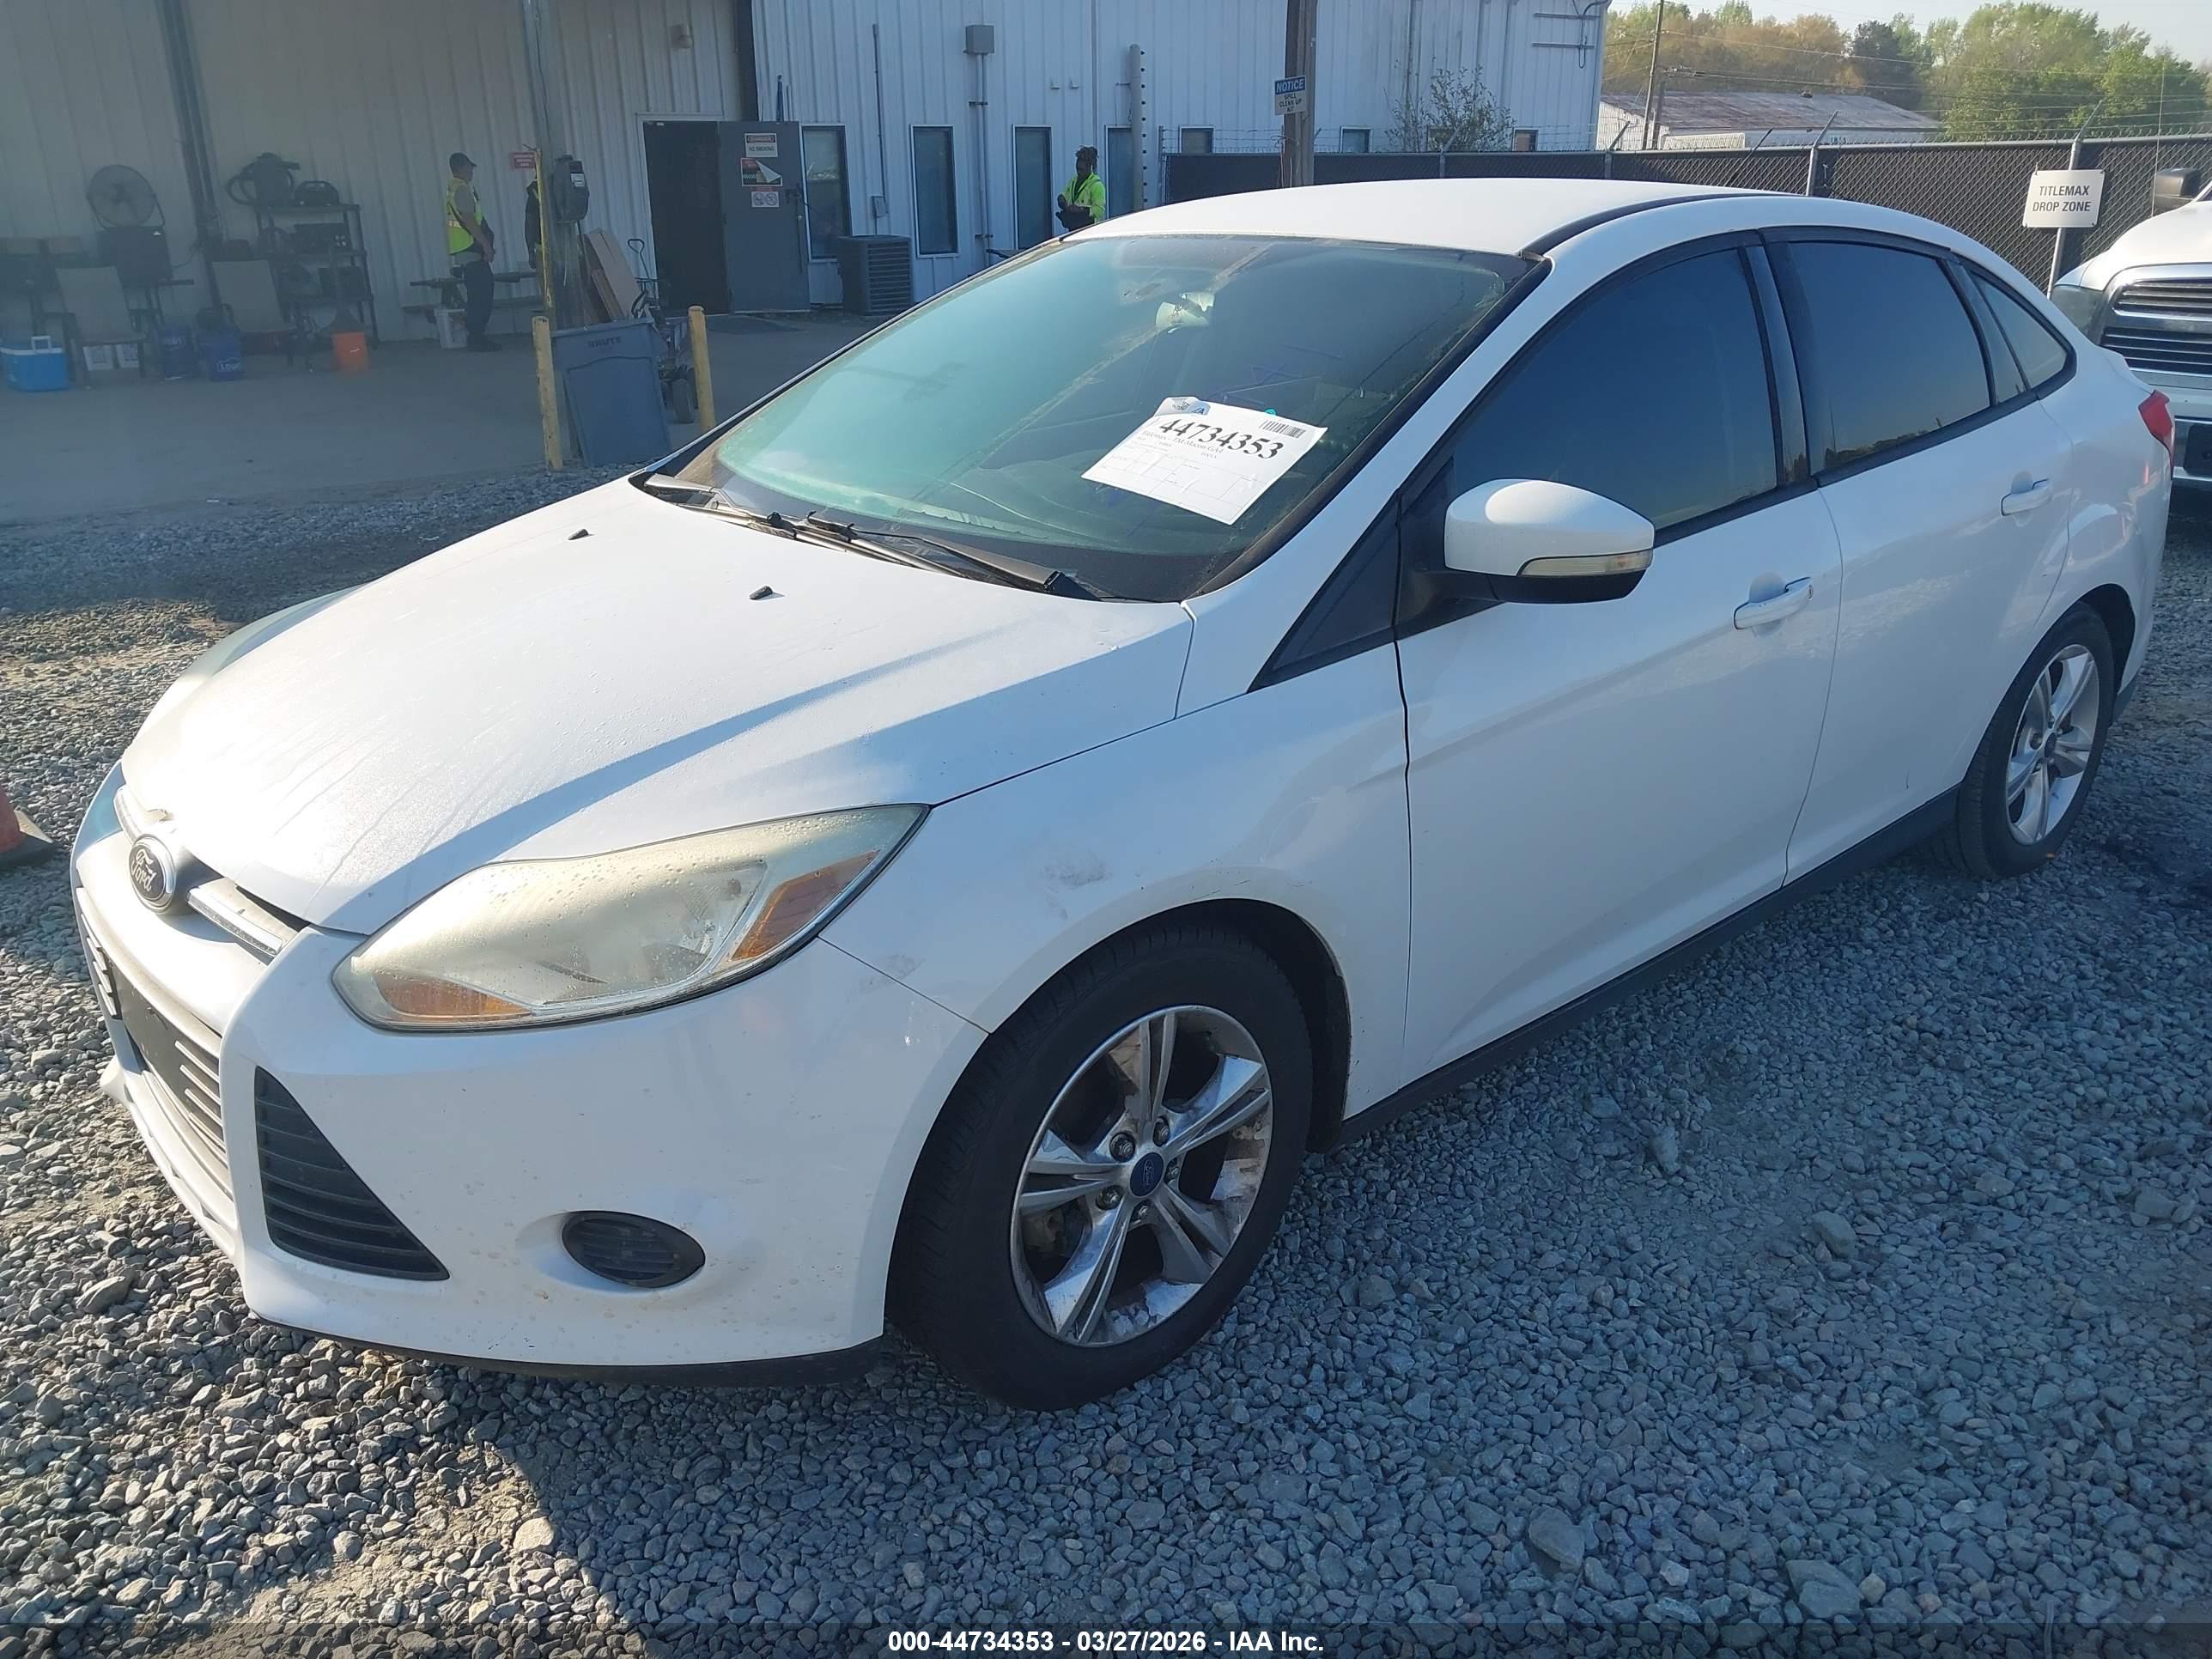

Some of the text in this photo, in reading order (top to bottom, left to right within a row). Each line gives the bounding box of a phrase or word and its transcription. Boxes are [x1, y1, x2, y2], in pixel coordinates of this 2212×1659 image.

[1276, 78, 1304, 93] NOTICE
[2039, 185, 2090, 197] TITLEMAX
[2033, 201, 2092, 213] DROP ZONE
[1159, 418, 1285, 459] 44734353
[131, 848, 158, 892] Ford
